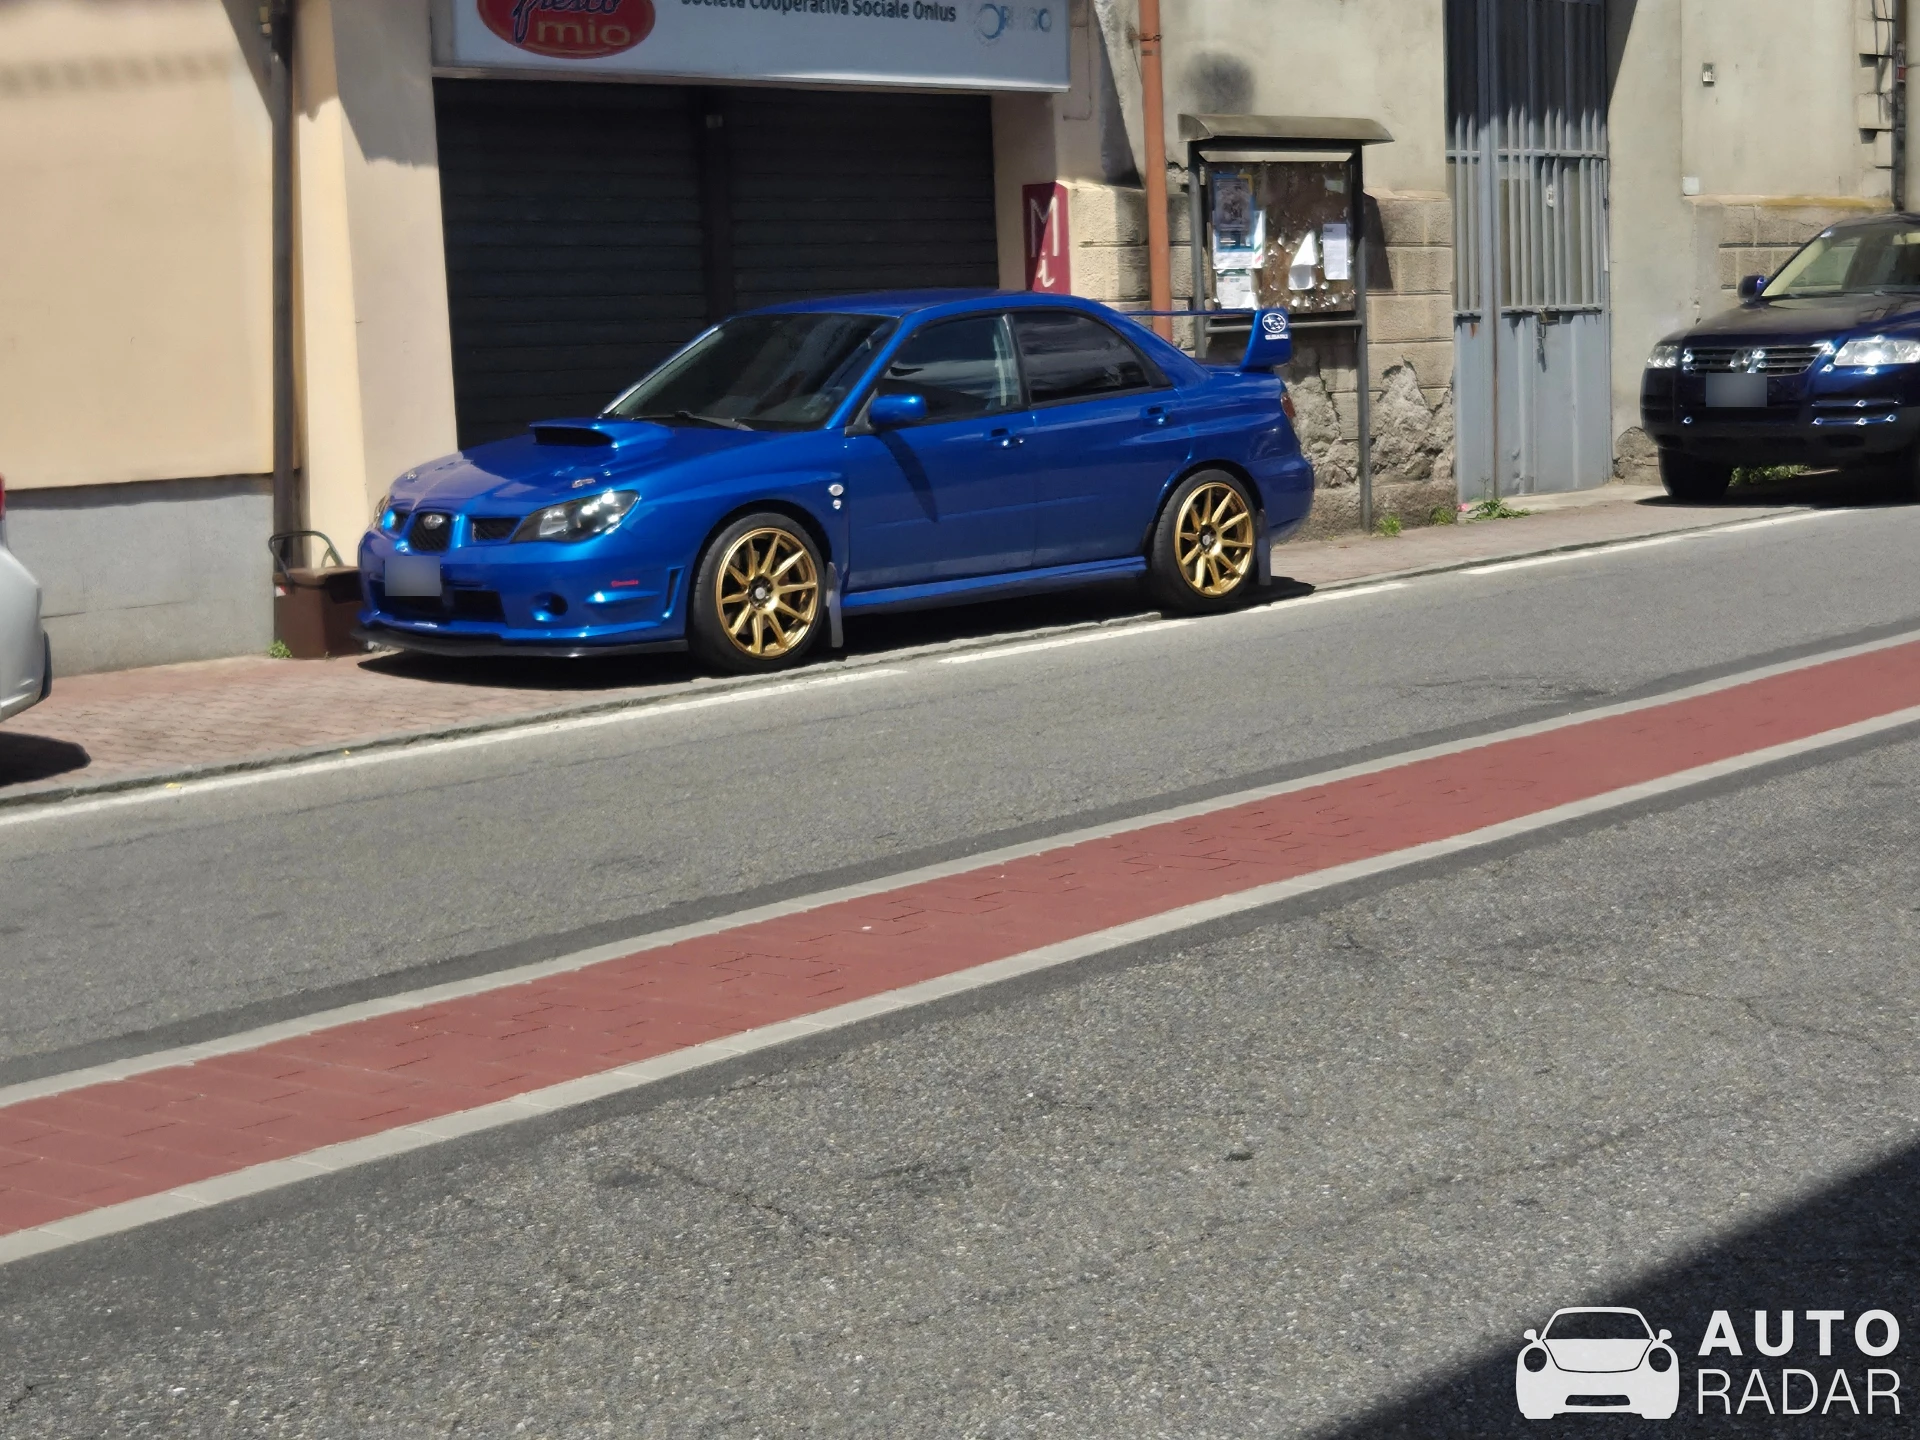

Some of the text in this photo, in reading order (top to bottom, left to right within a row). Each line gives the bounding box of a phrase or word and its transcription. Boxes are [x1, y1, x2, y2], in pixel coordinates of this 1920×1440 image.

[852, 0, 909, 19] Sociale
[912, 0, 957, 22] Onlus
[537, 19, 631, 46] mio
